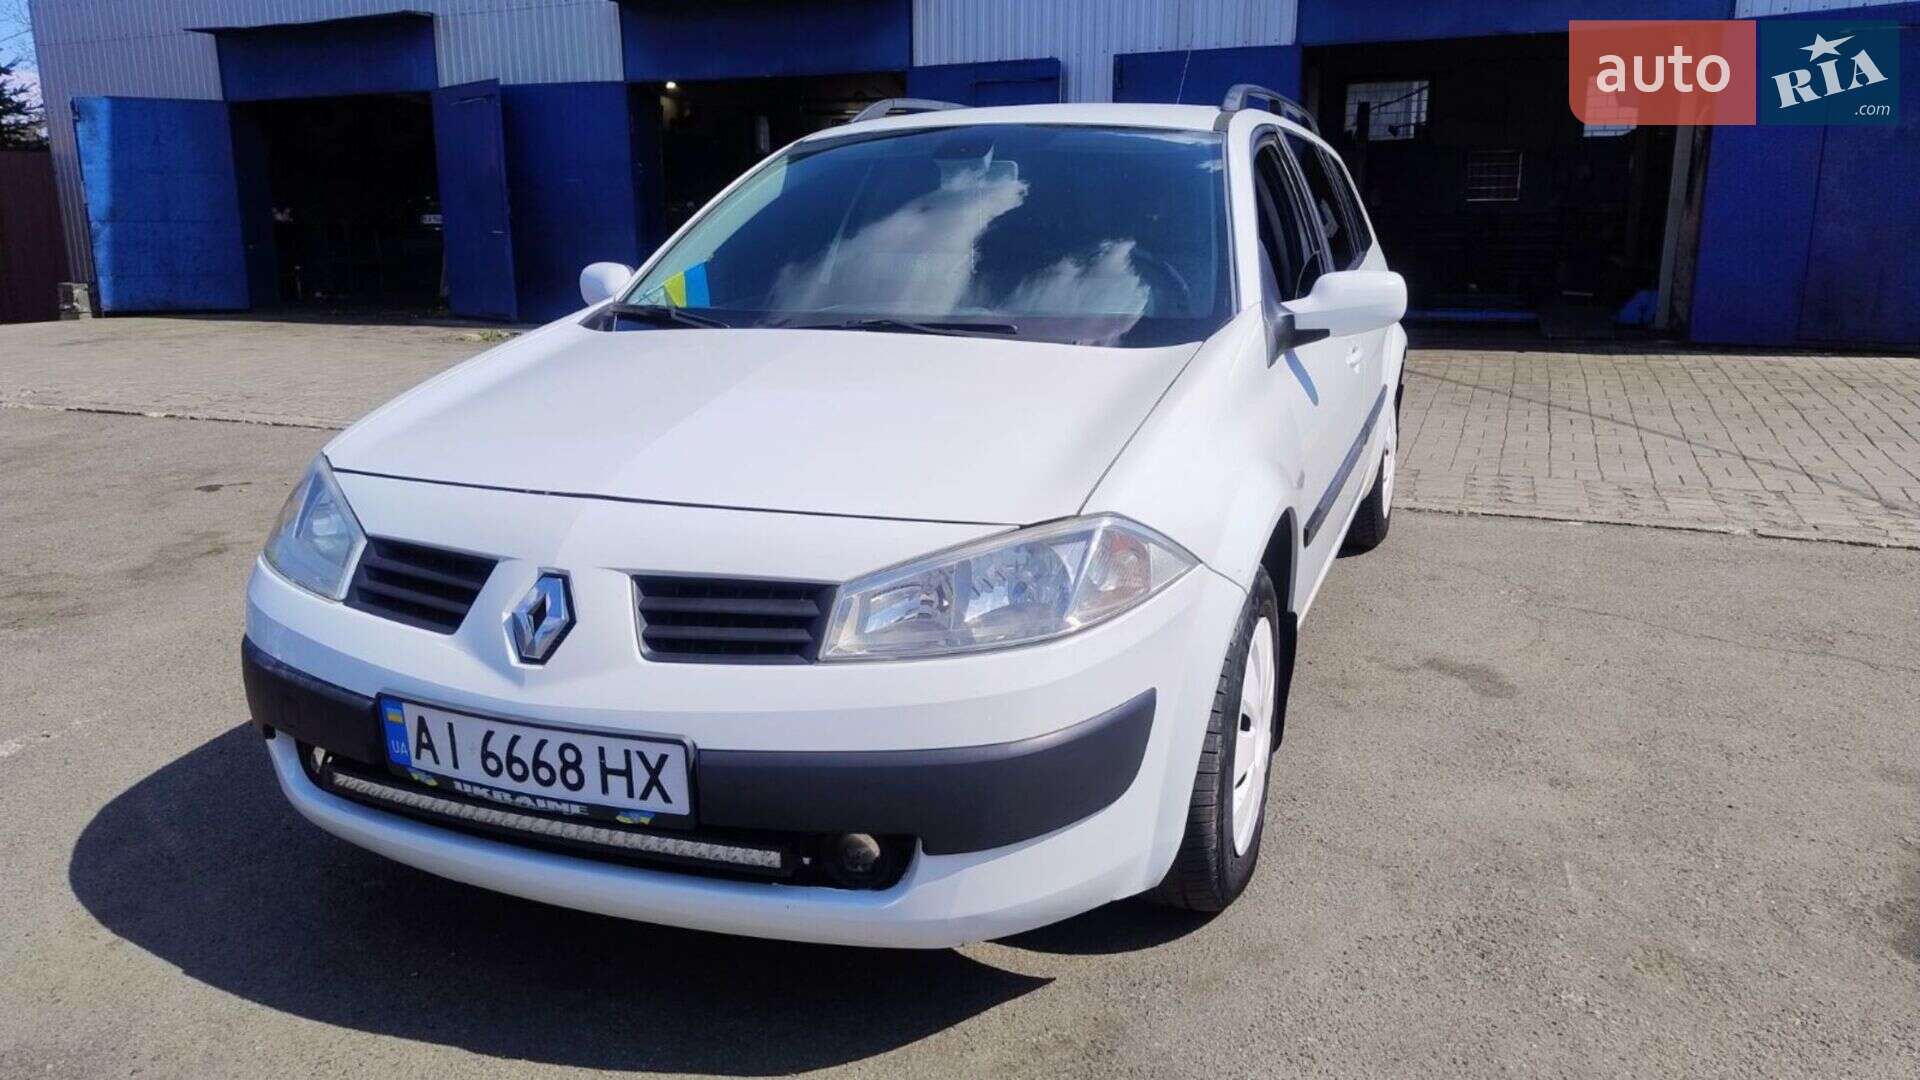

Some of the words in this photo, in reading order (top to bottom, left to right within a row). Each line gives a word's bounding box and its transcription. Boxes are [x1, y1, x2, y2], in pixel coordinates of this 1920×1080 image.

[391, 739, 409, 757] UA
[415, 715, 459, 770] AI
[480, 730, 585, 792] 6668
[598, 746, 673, 804] HX
